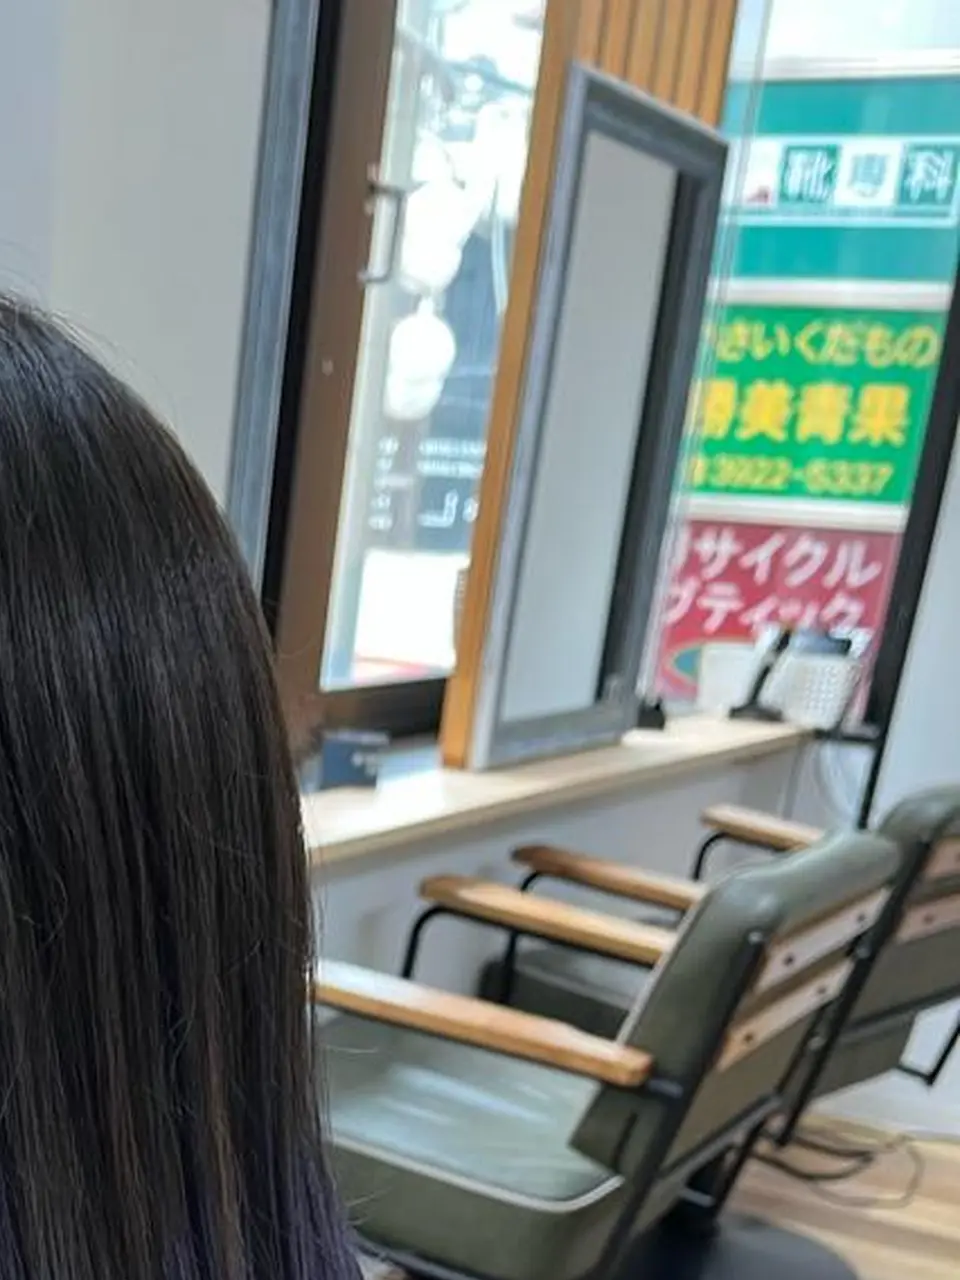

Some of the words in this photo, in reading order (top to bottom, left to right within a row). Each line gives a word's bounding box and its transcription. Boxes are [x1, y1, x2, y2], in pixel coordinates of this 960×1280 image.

[706, 317, 940, 368] さいくだもの
